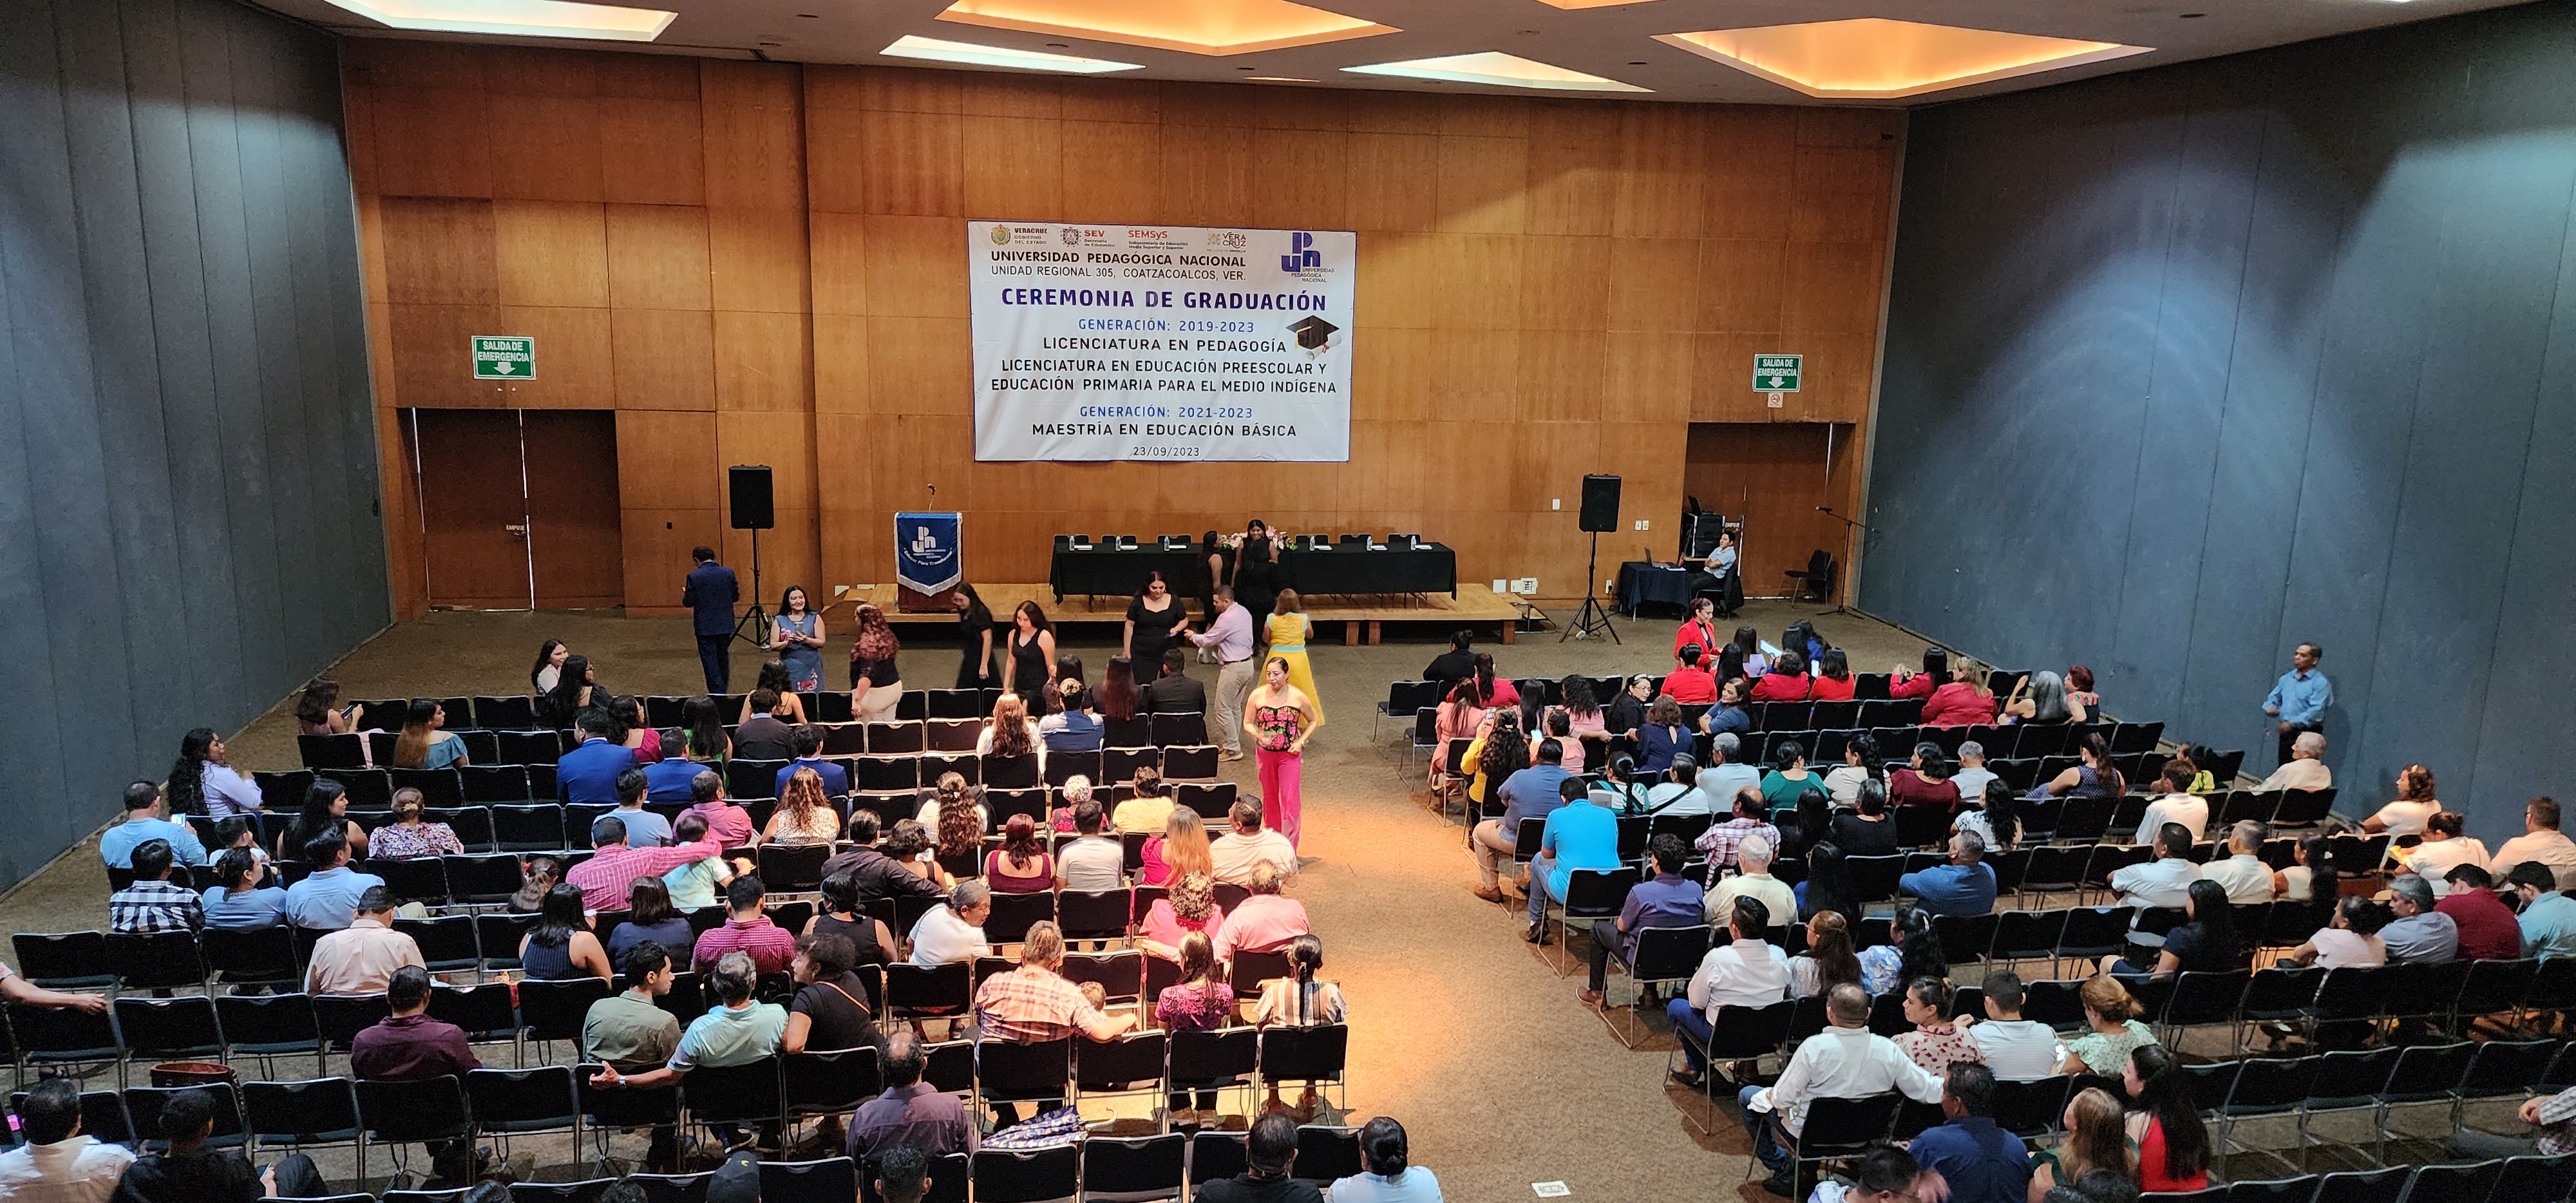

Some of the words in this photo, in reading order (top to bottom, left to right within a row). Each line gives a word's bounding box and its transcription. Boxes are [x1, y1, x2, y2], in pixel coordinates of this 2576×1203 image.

[1128, 230, 1168, 240] SEMSyS
[1222, 232, 1247, 240] VERA
[1222, 240, 1246, 249] CRUZ
[992, 251, 1079, 262] UNIVERSIDAD
[1088, 251, 1172, 265] PEDAGÓGICA
[1180, 256, 1245, 267] NACIONAL
[992, 265, 1032, 275] UNIDAD
[1037, 267, 1091, 276] REGIONAL
[1096, 268, 1115, 279] 305,
[1124, 269, 1218, 281] COATZACOALCOS,
[1223, 270, 1245, 280] VER.
[1002, 289, 1133, 307] CEREMONIA
[1146, 291, 1172, 307] DE
[1184, 290, 1325, 310] GRADUACIÓN
[1079, 317, 1170, 330] GENERACIÓN:
[1180, 321, 1253, 332] 2019-2023
[483, 341, 511, 350] SALIDA
[512, 341, 523, 351] DE
[1044, 337, 1160, 350] LICENCIATURA
[1170, 339, 1188, 350] EN
[1197, 338, 1286, 352] PEDAGOGÍA
[478, 352, 529, 362] EMERGENCIA
[1763, 358, 1784, 367] SALIDA
[1785, 359, 1794, 367] DE
[1002, 359, 1106, 371] LICENCIATURA
[1112, 361, 1128, 371] EN
[1136, 359, 1216, 373] EDUCACIÓN
[1223, 362, 1312, 374] PREESCOLAR
[1318, 364, 1327, 374] Y
[1757, 368, 1797, 377] EMERGENCIA
[992, 376, 1073, 390] EDUCACIÓN
[1084, 379, 1152, 390] PRIMARIA
[1159, 380, 1195, 391] PARA
[1202, 381, 1216, 392] EL
[1222, 381, 1264, 392] MEDIO
[1271, 379, 1336, 393] INDÍGENA
[1081, 404, 1169, 417] GENERACIÓN:
[1179, 407, 1252, 418] 2021-2023
[1033, 421, 1112, 435] MAESTRÍA
[1120, 424, 1137, 435] EN
[1147, 422, 1233, 435] EDUCACIÓN
[1242, 422, 1296, 436] BÁSICA
[1133, 446, 1198, 457] 23/09/2023
